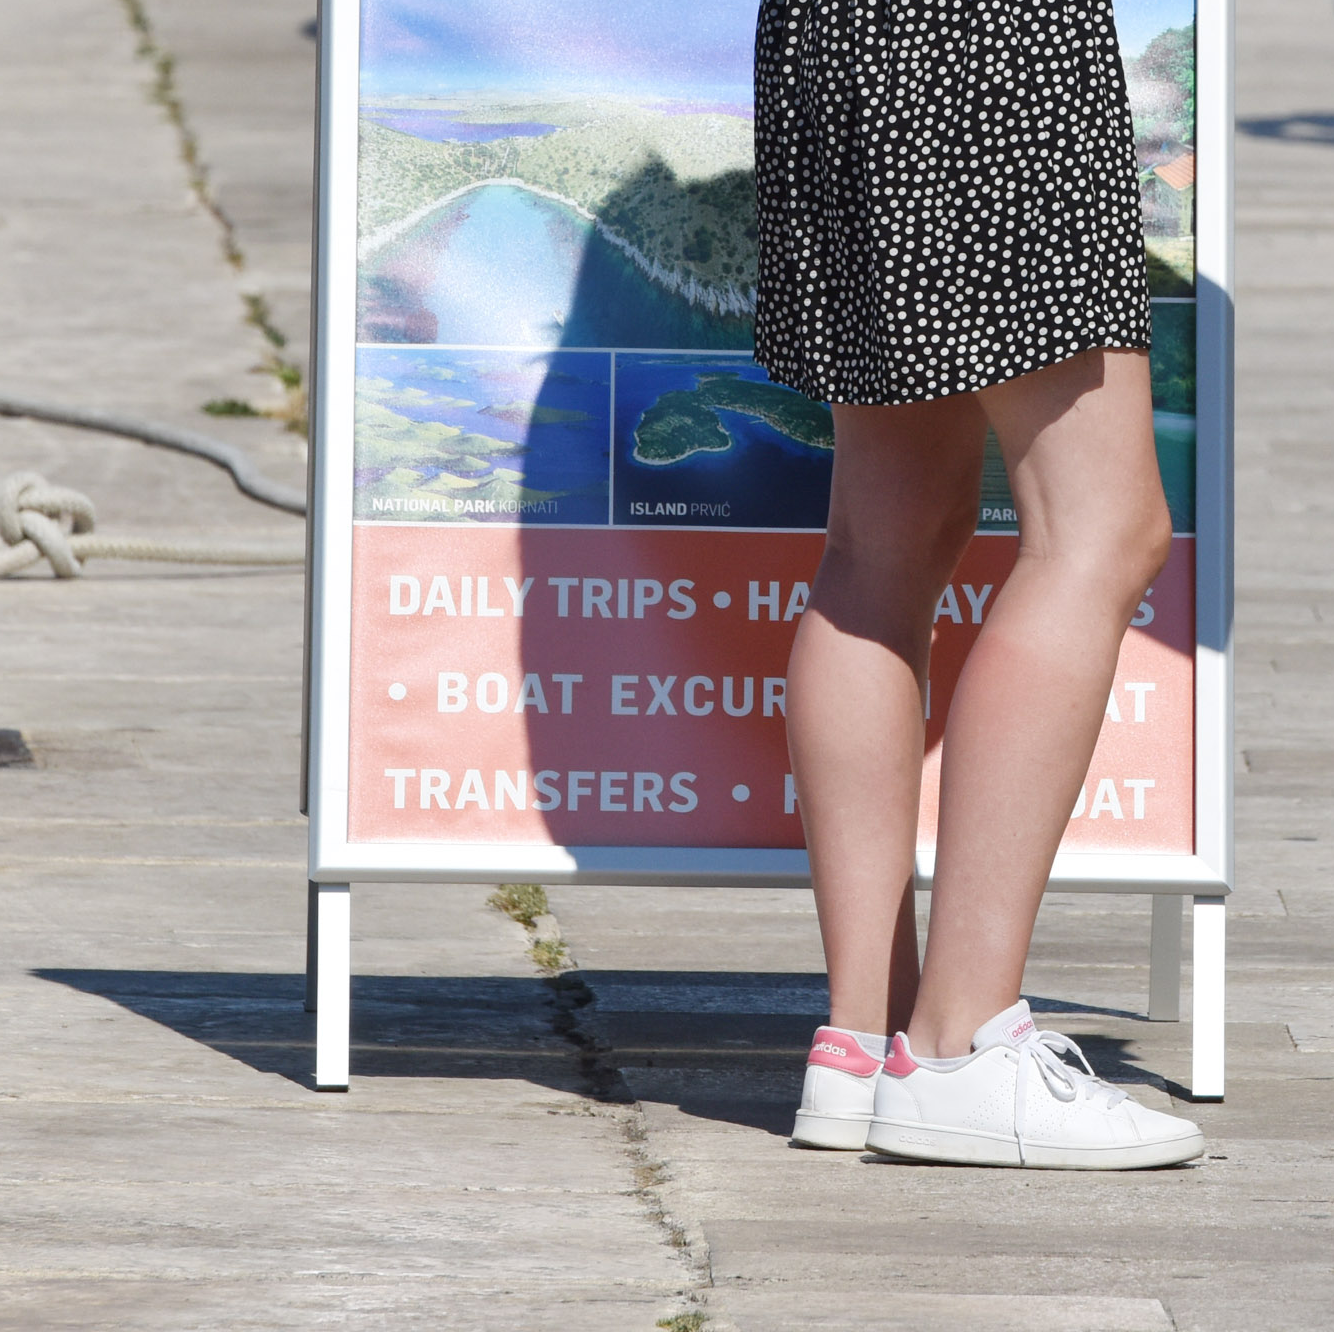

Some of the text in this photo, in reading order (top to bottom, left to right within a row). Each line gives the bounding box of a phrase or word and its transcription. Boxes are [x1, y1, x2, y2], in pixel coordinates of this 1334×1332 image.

[372, 498, 558, 515] NATIONAL PARK KORNATI
[630, 500, 731, 517] ISLAND PRVIĆ
[388, 574, 534, 617] DAILY
[548, 577, 697, 620] TRIPS
[933, 584, 994, 624] AY
[436, 672, 583, 715] BOAT
[383, 768, 699, 813] TRANSFERS
